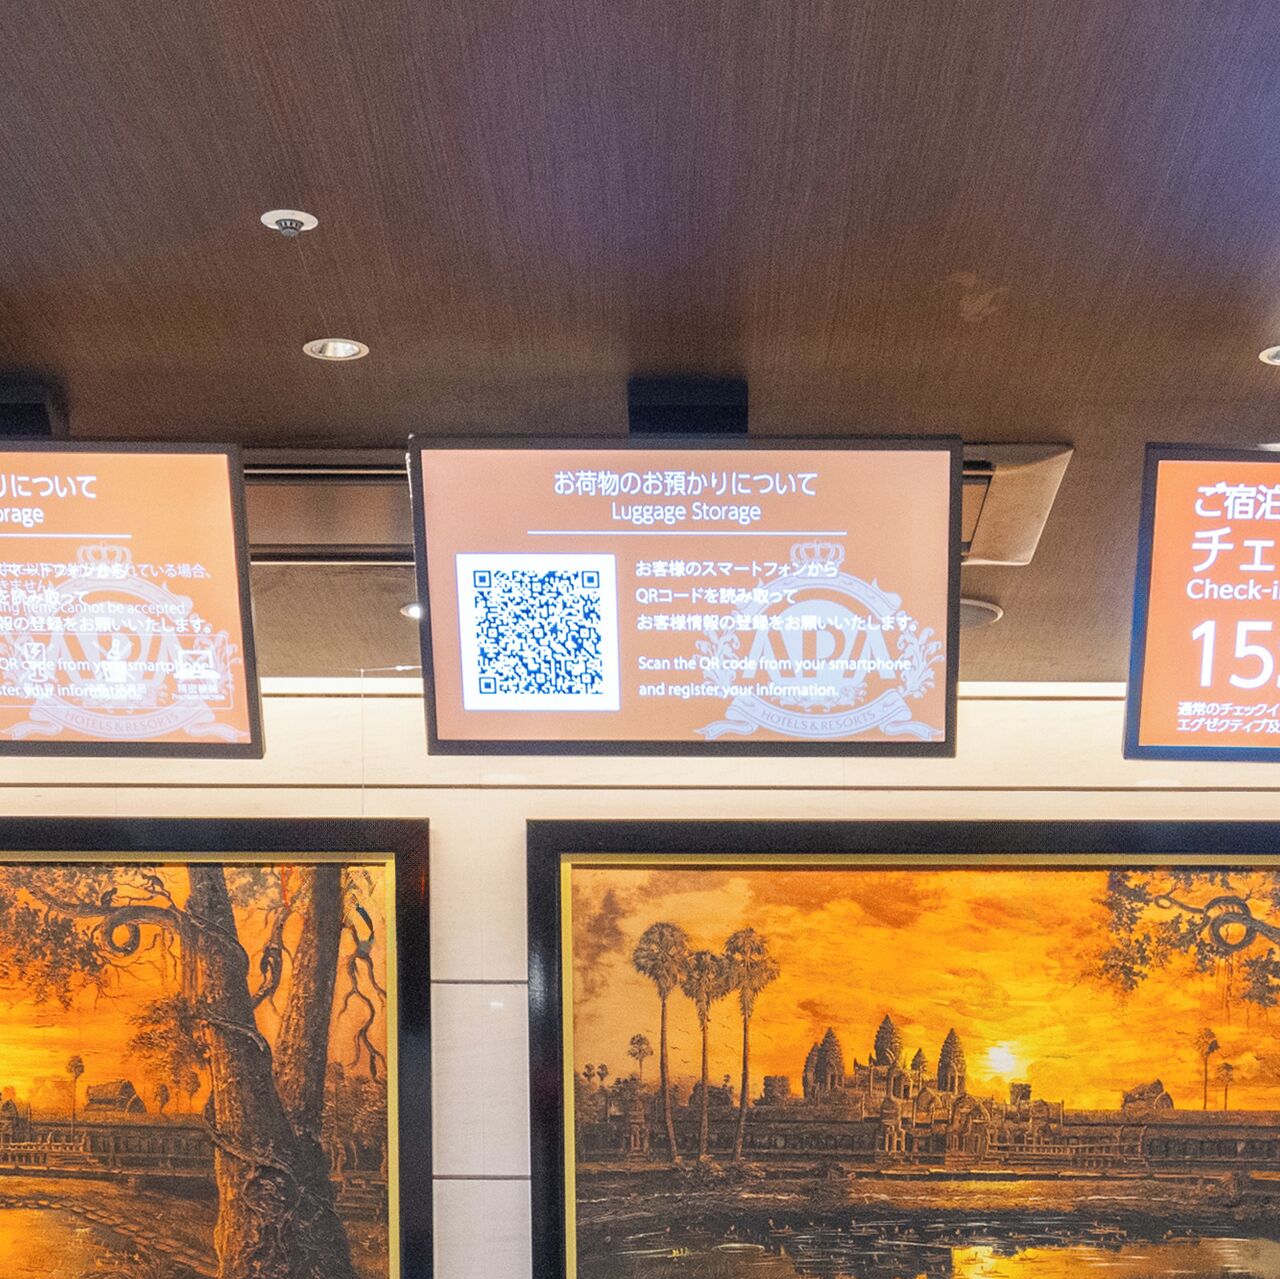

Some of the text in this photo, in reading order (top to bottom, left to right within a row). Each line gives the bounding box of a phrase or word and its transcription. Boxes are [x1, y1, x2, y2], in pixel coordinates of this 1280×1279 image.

[553, 470, 817, 497] お荷物のお預かりについて
[612, 502, 761, 524] Luggage Storage
[635, 560, 839, 578] お客様のスマートフォンから
[635, 588, 798, 604] QRコードを読み取って
[108, 601, 124, 613] be
[637, 615, 918, 631] お客様情報の登録をお願いいたします。
[58, 658, 90, 672] from
[638, 656, 912, 674] Scan the QR code from your smartphone
[639, 683, 839, 700] and register your information.
